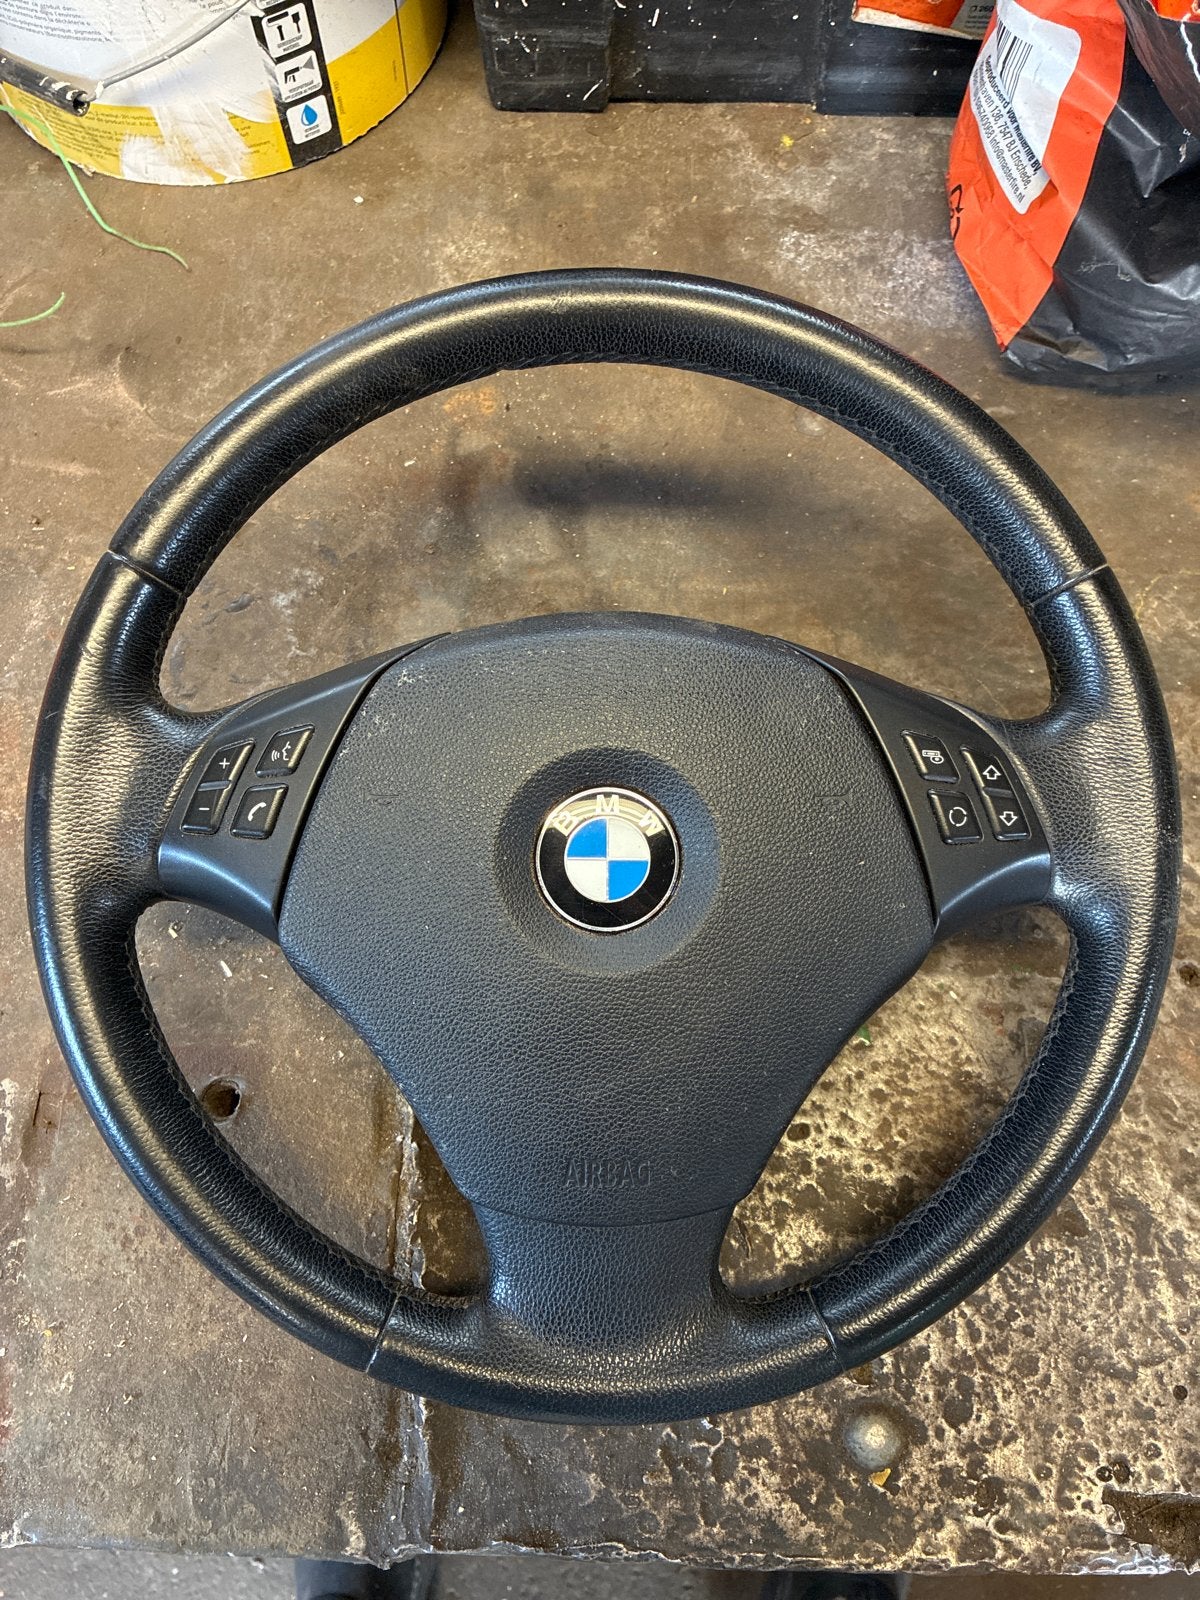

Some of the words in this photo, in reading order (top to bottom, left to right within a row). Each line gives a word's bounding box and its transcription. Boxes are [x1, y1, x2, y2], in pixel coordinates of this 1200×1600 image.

[997, 121, 1013, 141] 7547
[1005, 139, 1018, 153] BJ
[1010, 149, 1032, 190] Enschede,
[551, 794, 665, 837] BMW
[565, 1159, 651, 1188] AIRBAG
